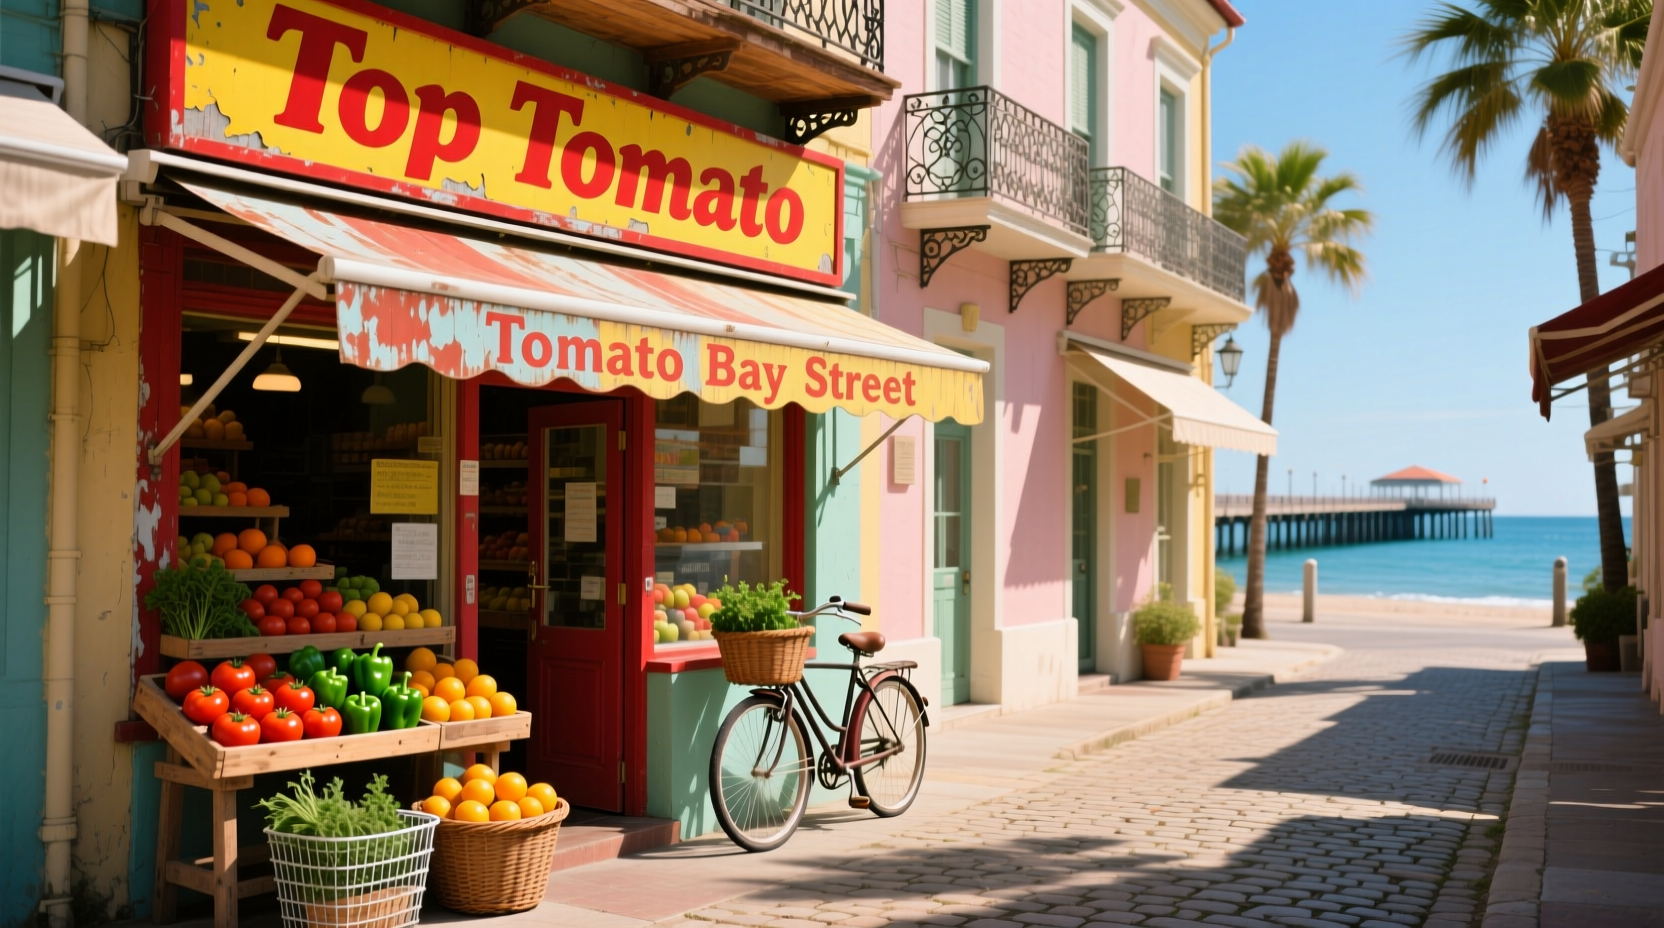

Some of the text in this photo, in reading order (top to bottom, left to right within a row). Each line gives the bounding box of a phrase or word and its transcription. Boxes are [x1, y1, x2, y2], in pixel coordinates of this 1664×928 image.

[266, 3, 805, 245] Top Tomato
[485, 312, 916, 407] Tomato Bay Street
